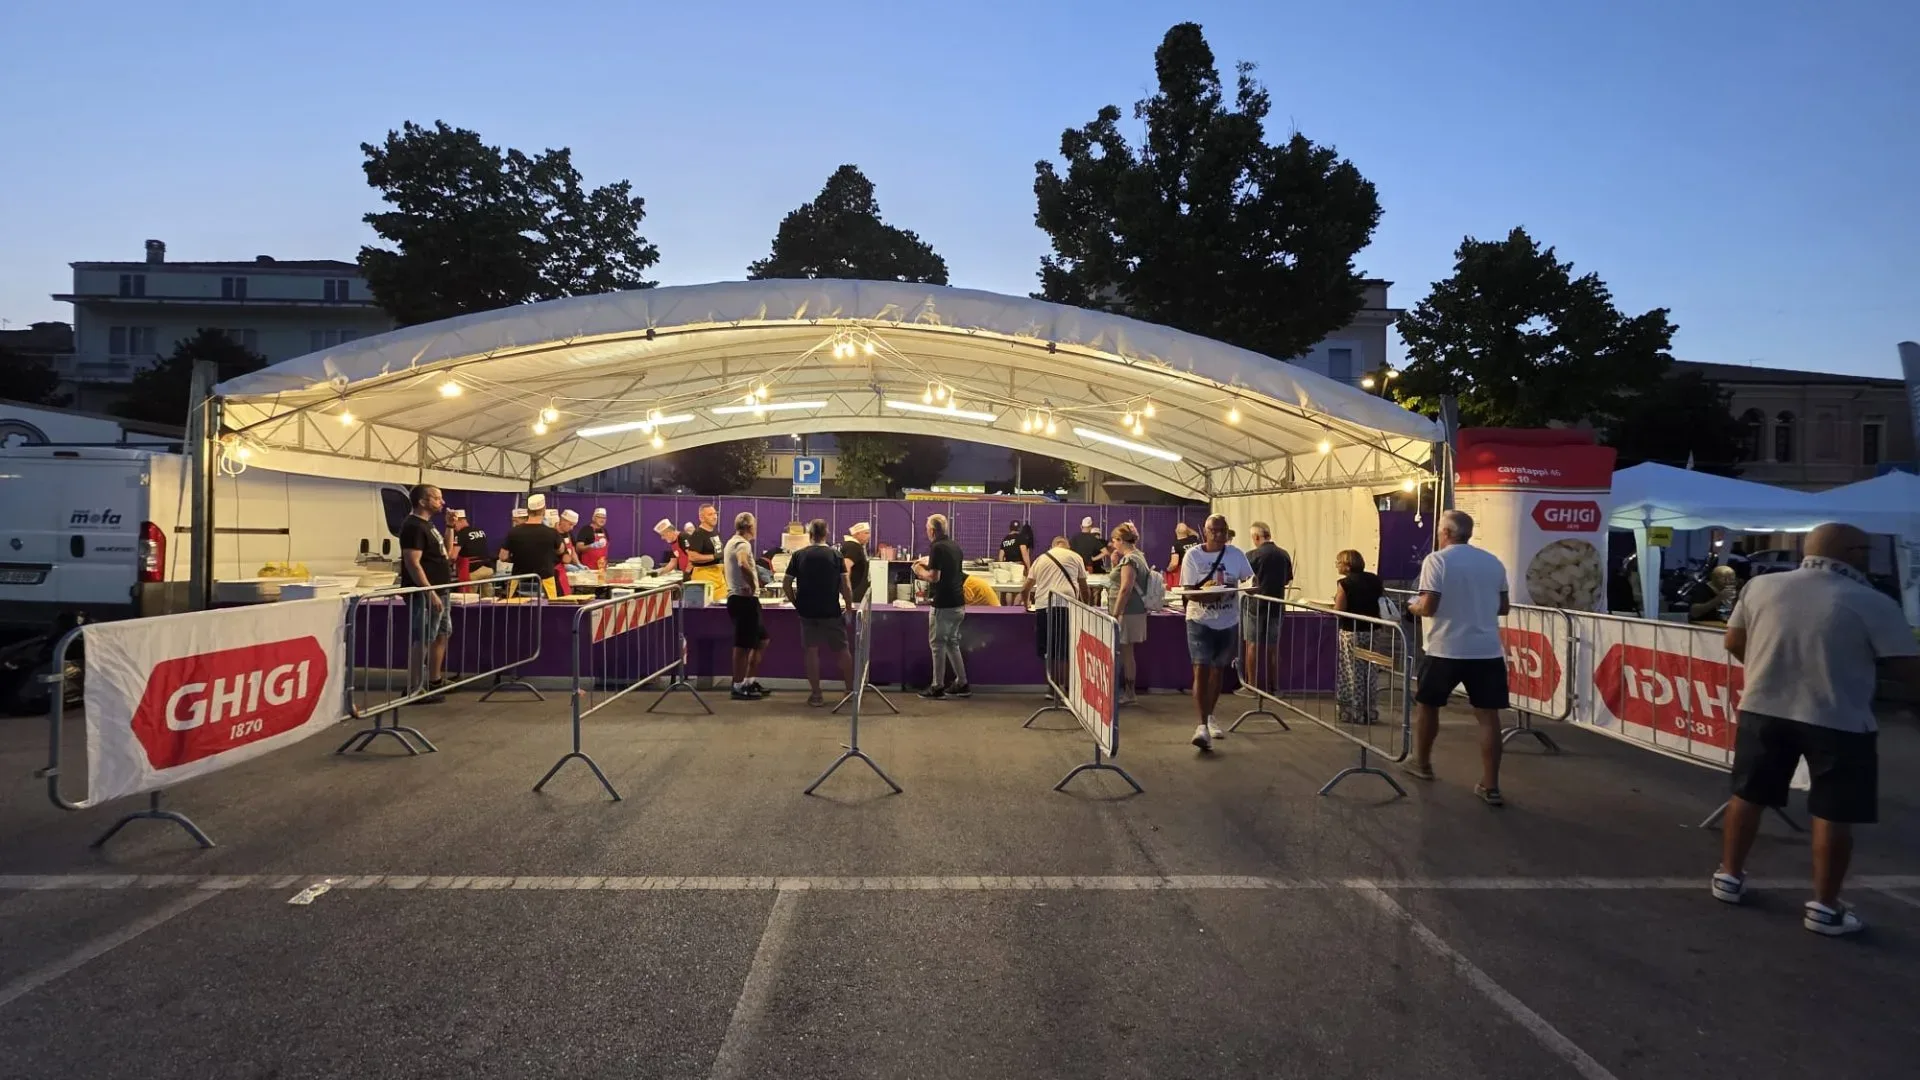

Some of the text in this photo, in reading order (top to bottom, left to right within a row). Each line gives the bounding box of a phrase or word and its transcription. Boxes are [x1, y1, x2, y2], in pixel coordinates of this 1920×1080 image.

[800, 460, 815, 481] P
[1498, 466, 1549, 476] cavatappi
[1544, 508, 1596, 523] GHIGI
[229, 718, 264, 741] 1870
